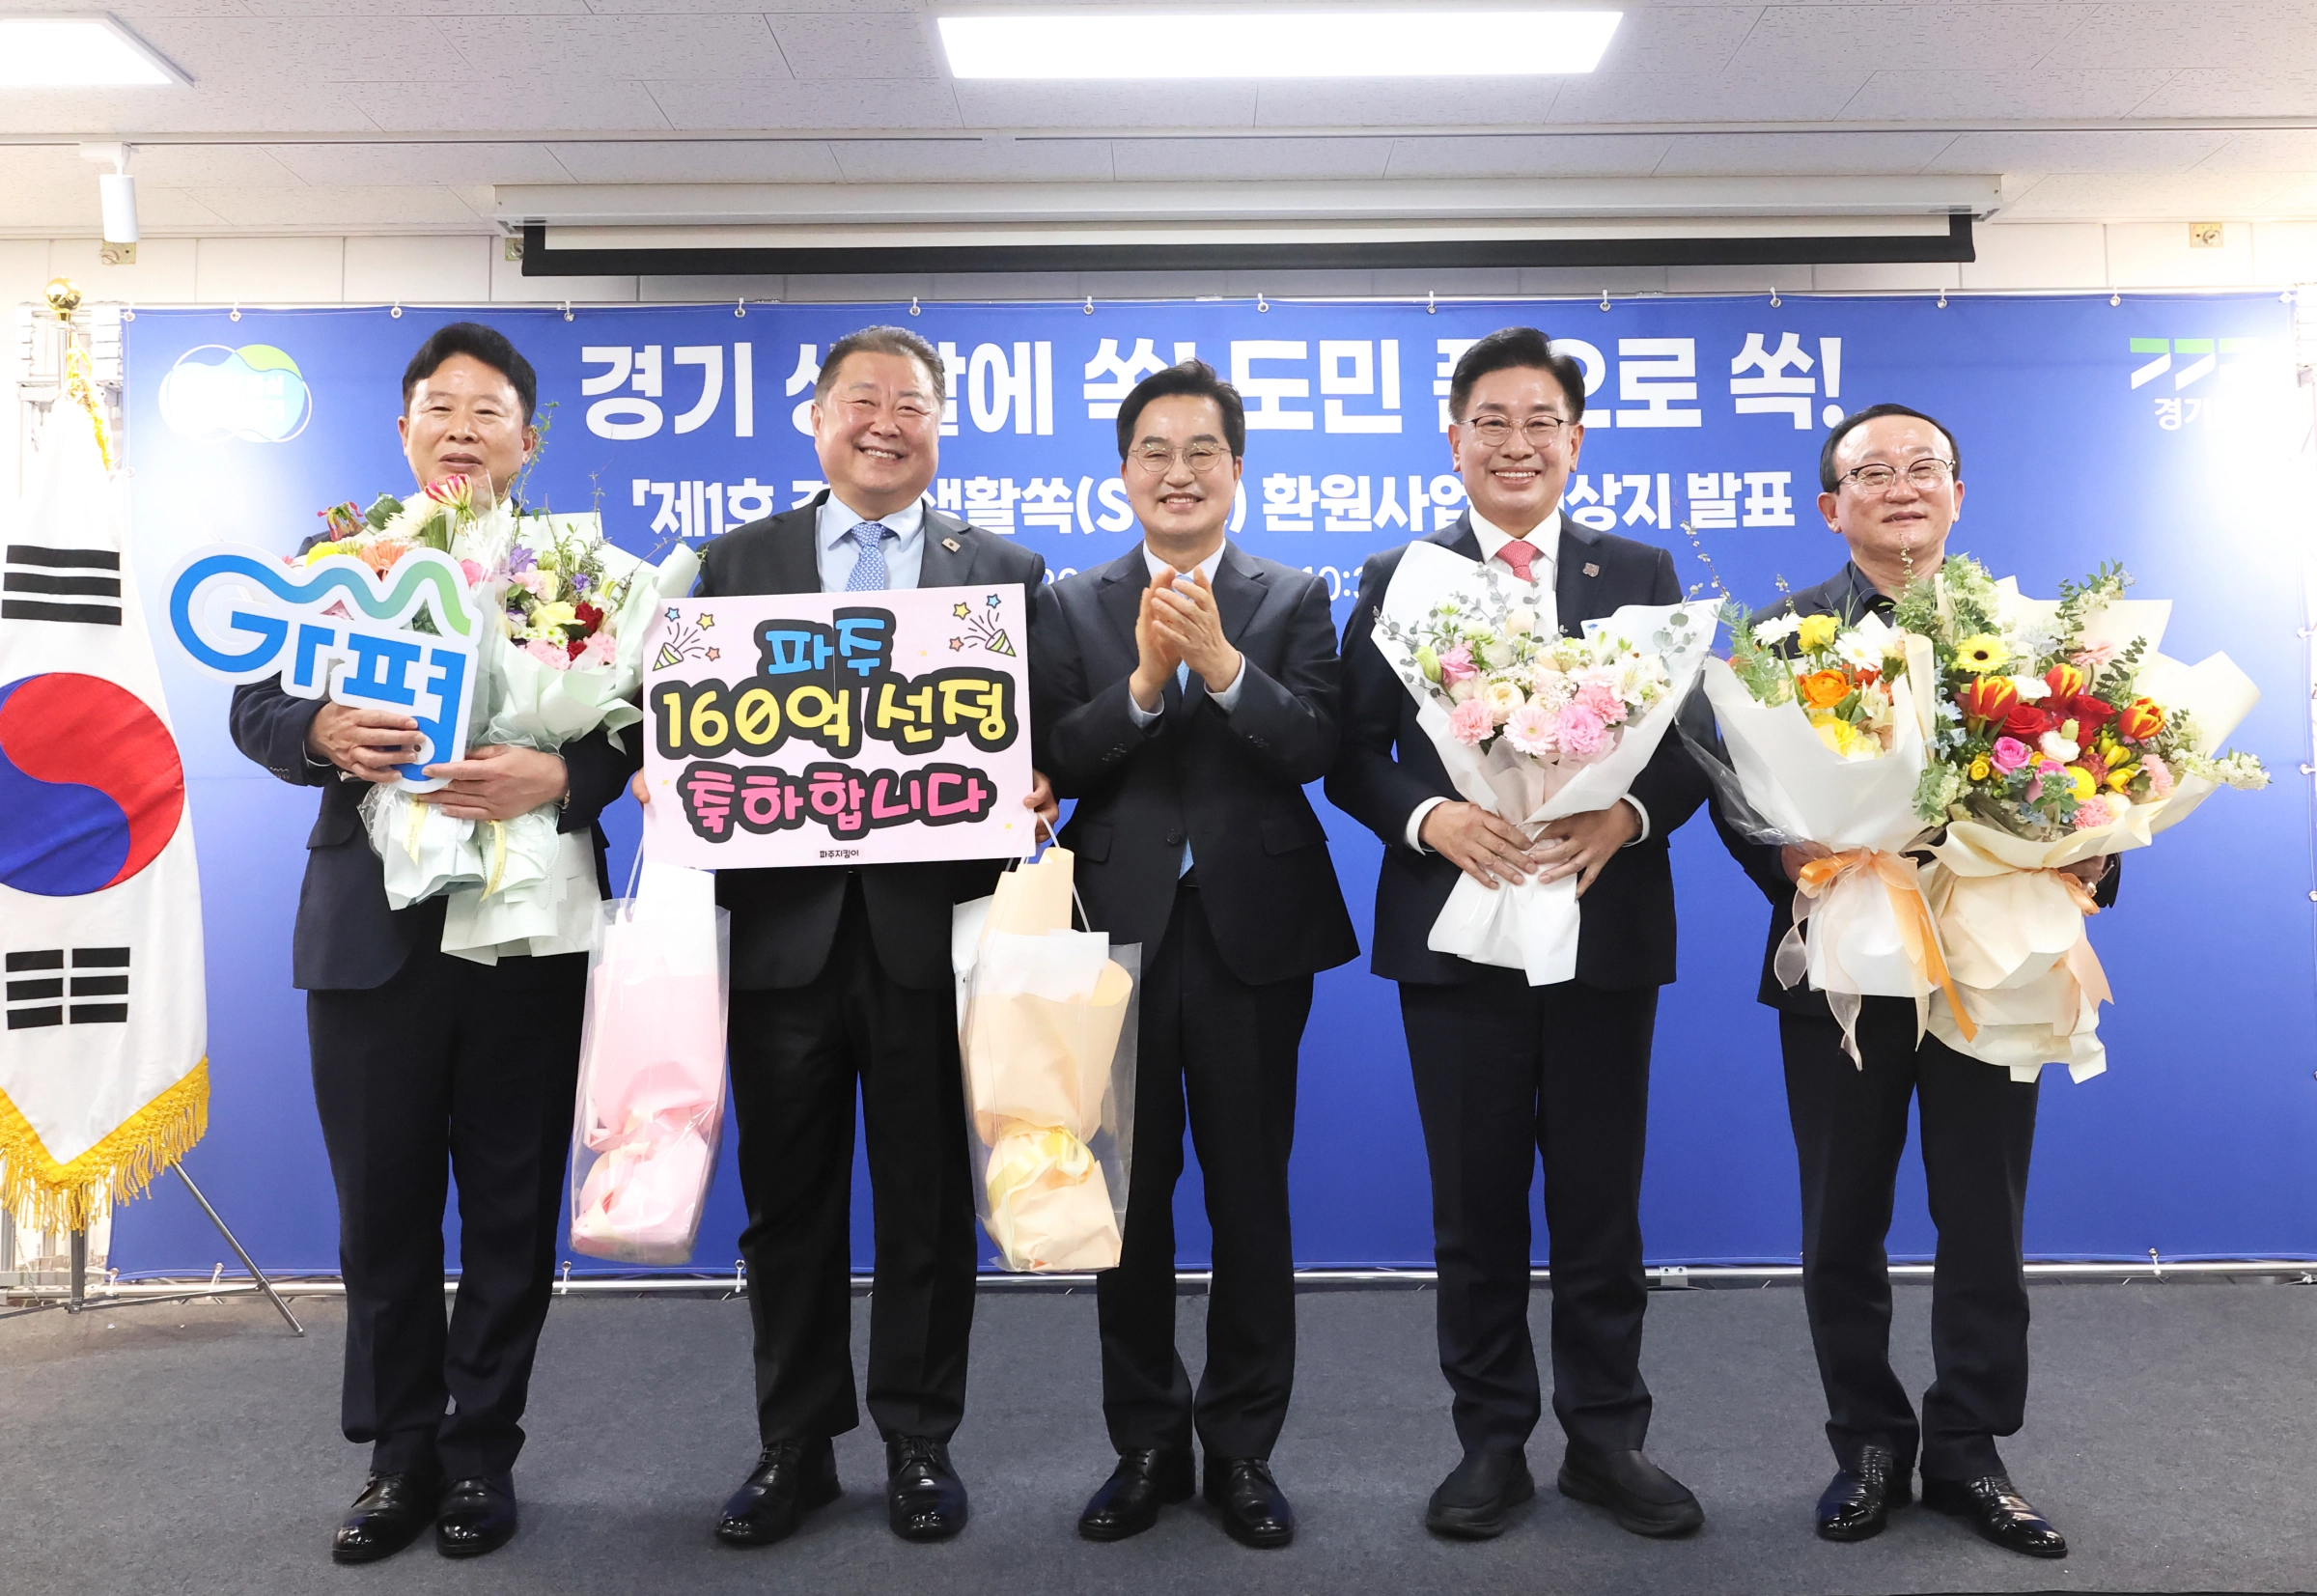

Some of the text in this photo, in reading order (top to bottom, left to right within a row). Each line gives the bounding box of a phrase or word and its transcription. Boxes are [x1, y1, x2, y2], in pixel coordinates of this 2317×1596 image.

[581, 342, 754, 441] 경기
[1230, 338, 1403, 434] 도민
[1730, 332, 1845, 431] 쏙!
[1562, 473, 1673, 531] 상지
[1687, 471, 1796, 529] 발표
[765, 617, 886, 677] 파주
[662, 678, 1006, 748] 160억 선정
[686, 770, 988, 834] 축하합니다
